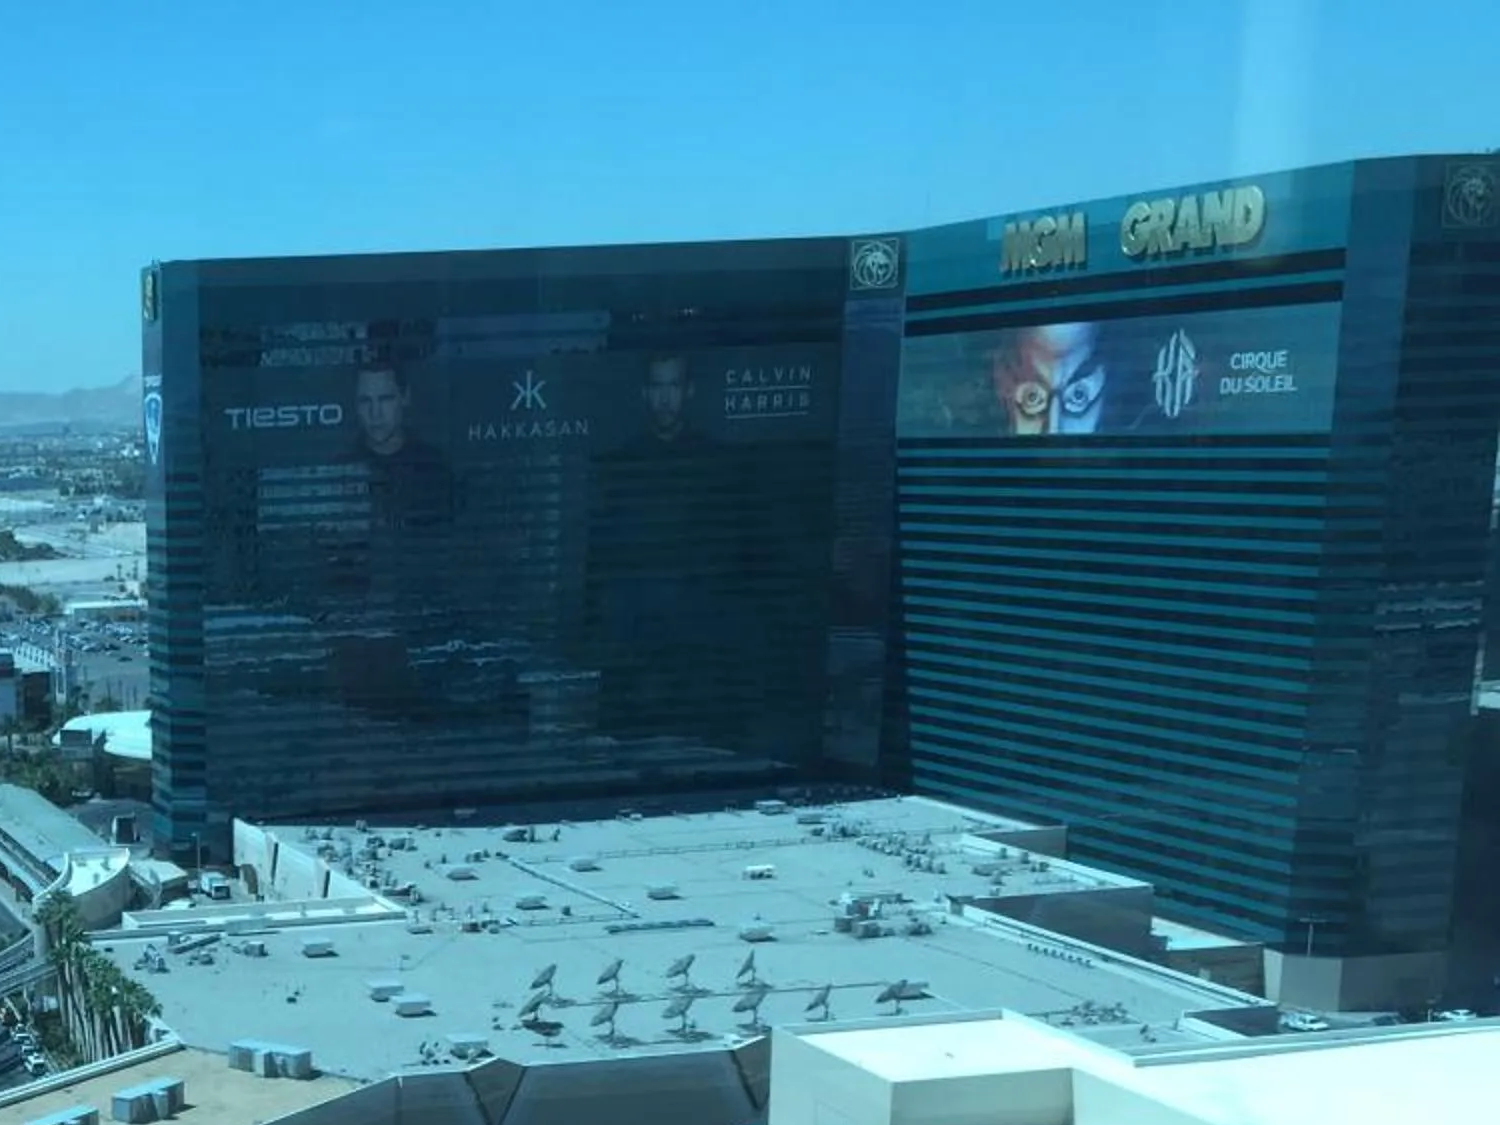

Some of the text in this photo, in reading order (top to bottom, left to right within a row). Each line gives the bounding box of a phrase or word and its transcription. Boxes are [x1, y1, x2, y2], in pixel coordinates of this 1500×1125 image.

[1000, 184, 1266, 271] MGM GRAND
[1230, 349, 1289, 374] CIRQUE
[725, 364, 812, 385] CALVIN
[1219, 374, 1298, 394] DU SOLEIL
[467, 419, 590, 441] HAKKASAN
